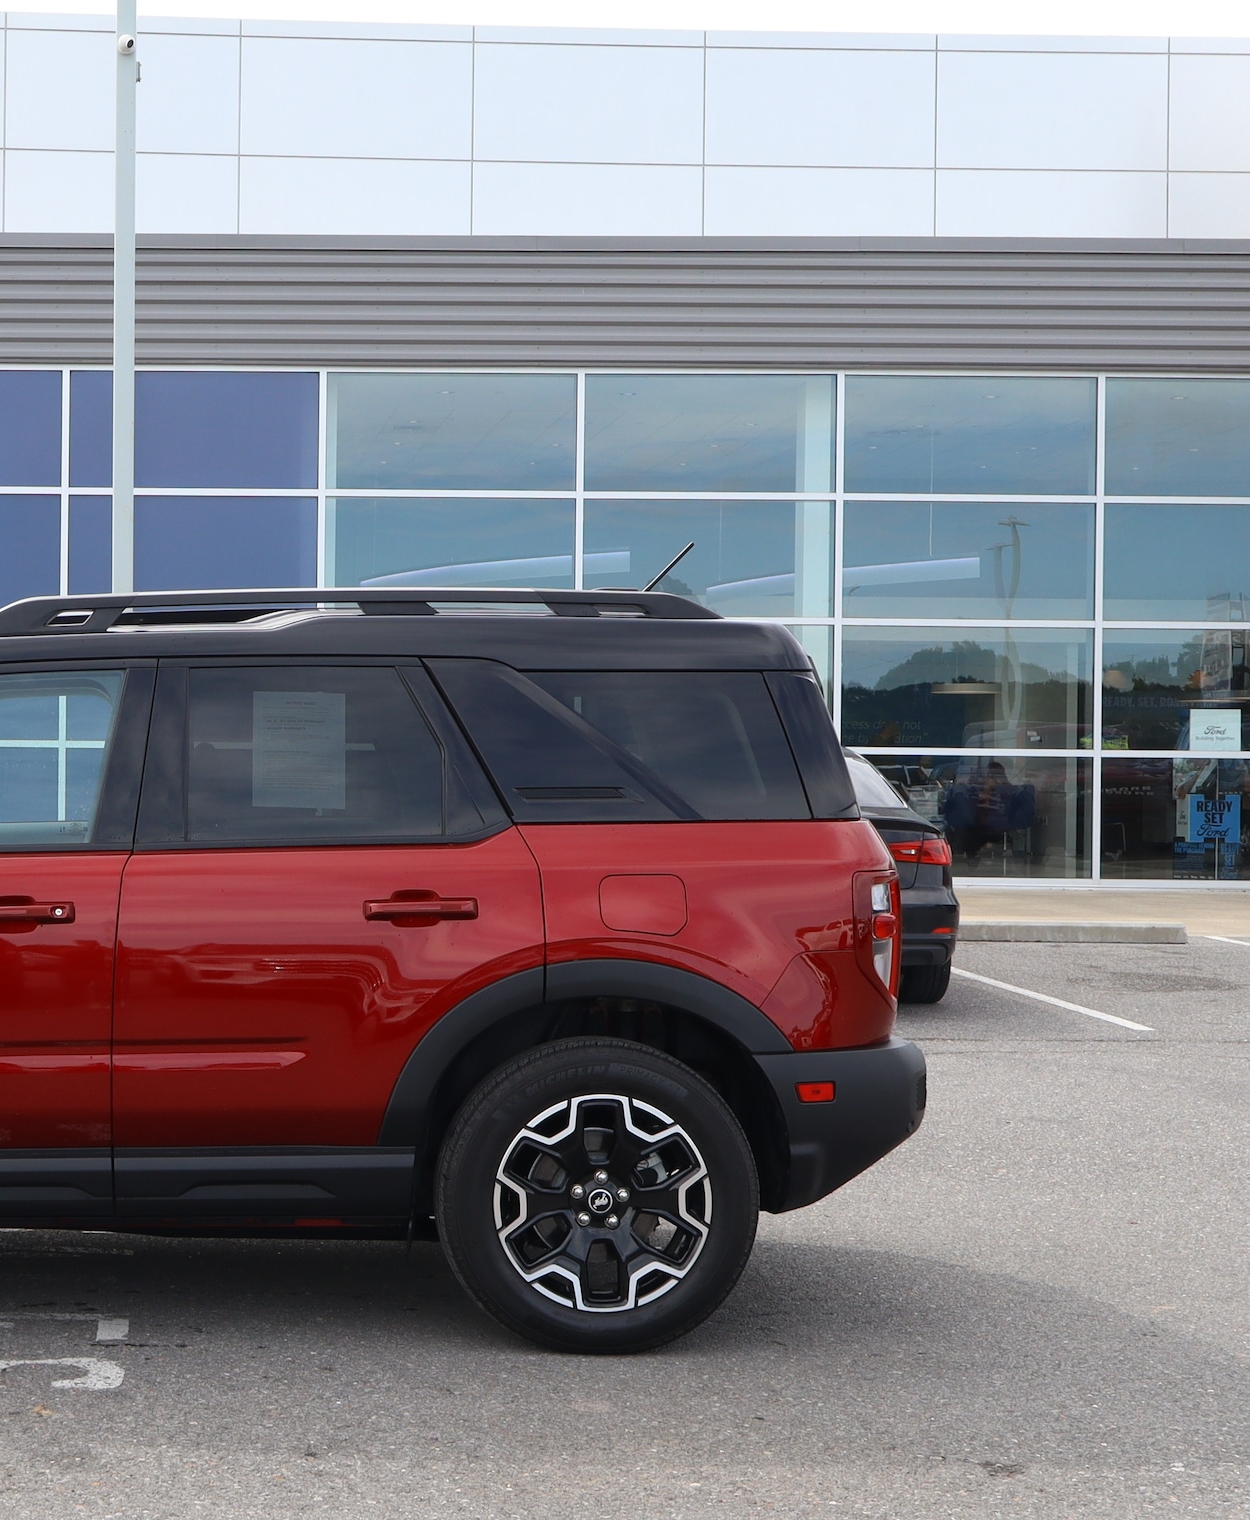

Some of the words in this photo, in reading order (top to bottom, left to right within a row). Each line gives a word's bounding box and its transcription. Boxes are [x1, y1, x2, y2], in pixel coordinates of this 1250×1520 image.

[1204, 725, 1227, 735] Ford
[1196, 801, 1233, 812] READY
[1204, 813, 1224, 824] SET
[1196, 824, 1231, 837] Ford
[525, 1065, 606, 1096] MICHELIN
